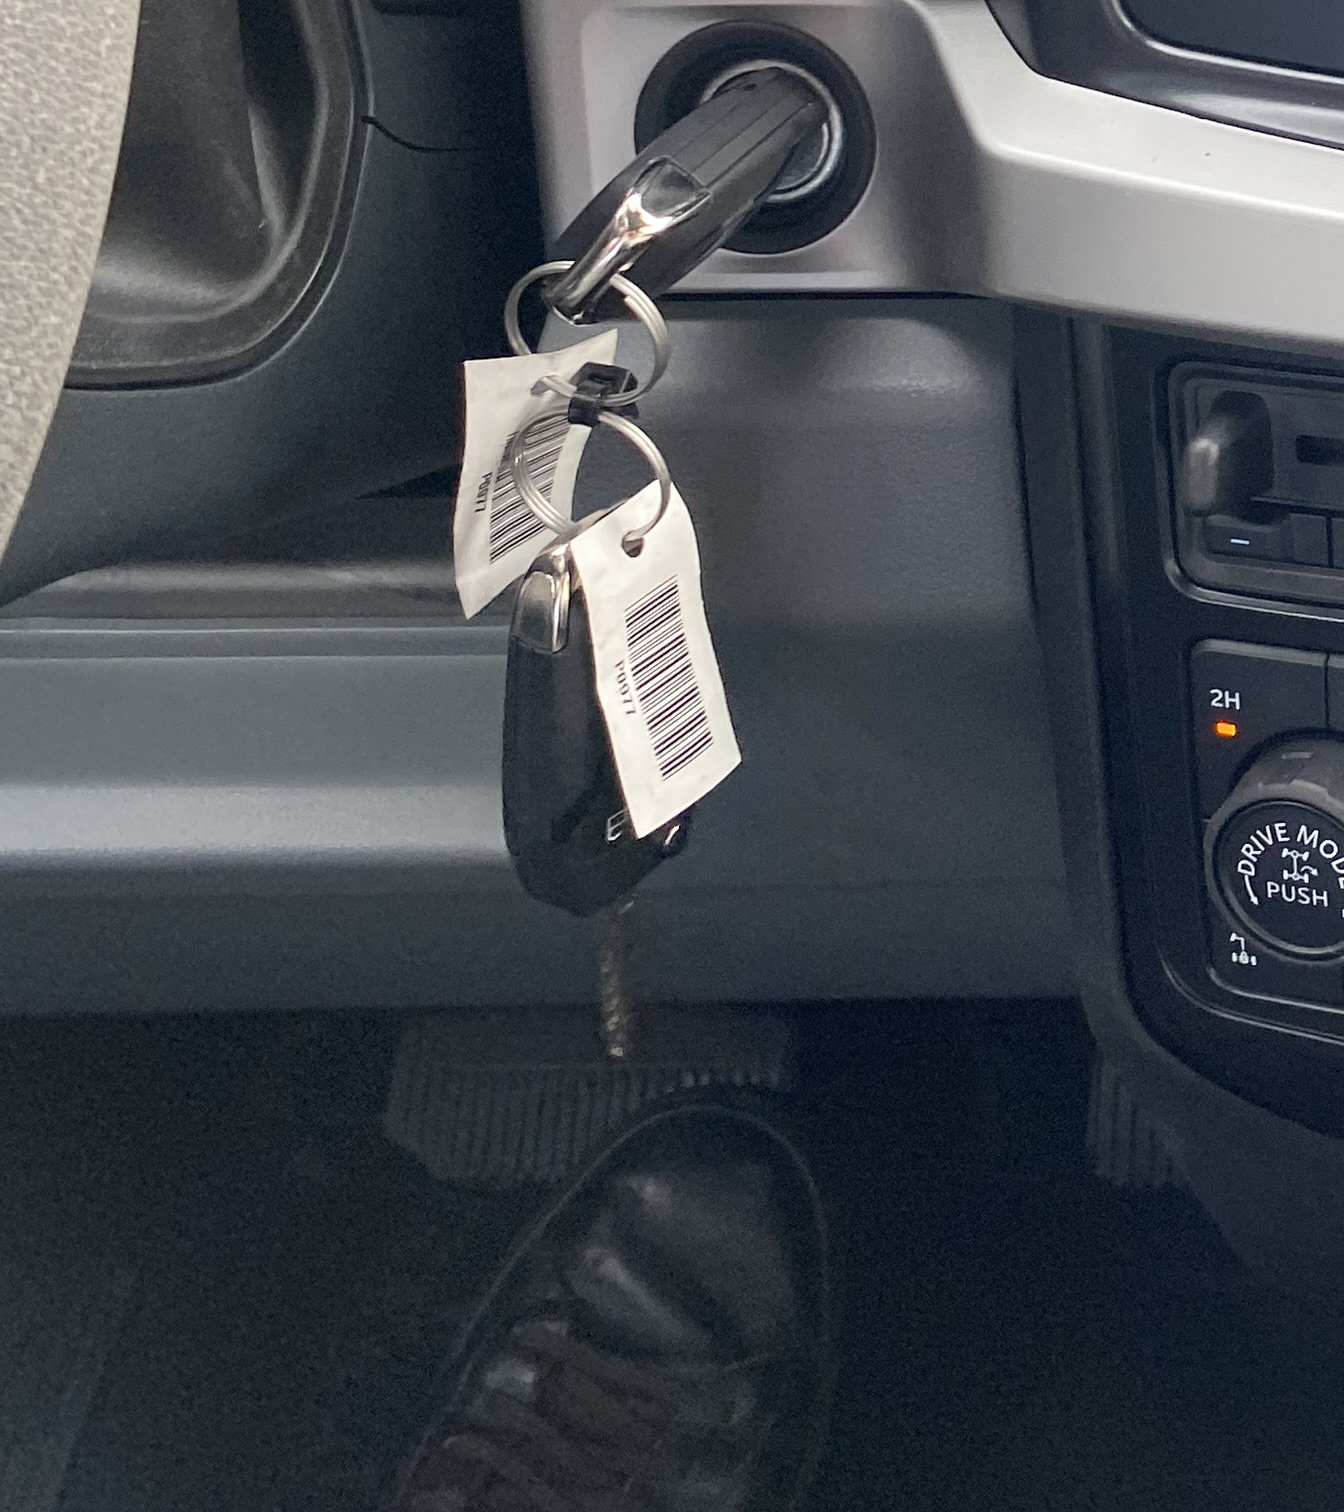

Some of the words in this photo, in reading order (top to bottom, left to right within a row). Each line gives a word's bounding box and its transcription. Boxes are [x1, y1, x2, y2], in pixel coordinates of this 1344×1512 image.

[1210, 689, 1241, 710] 2H
[1237, 822, 1290, 876] DRIVE
[1266, 881, 1328, 907] PUSH
